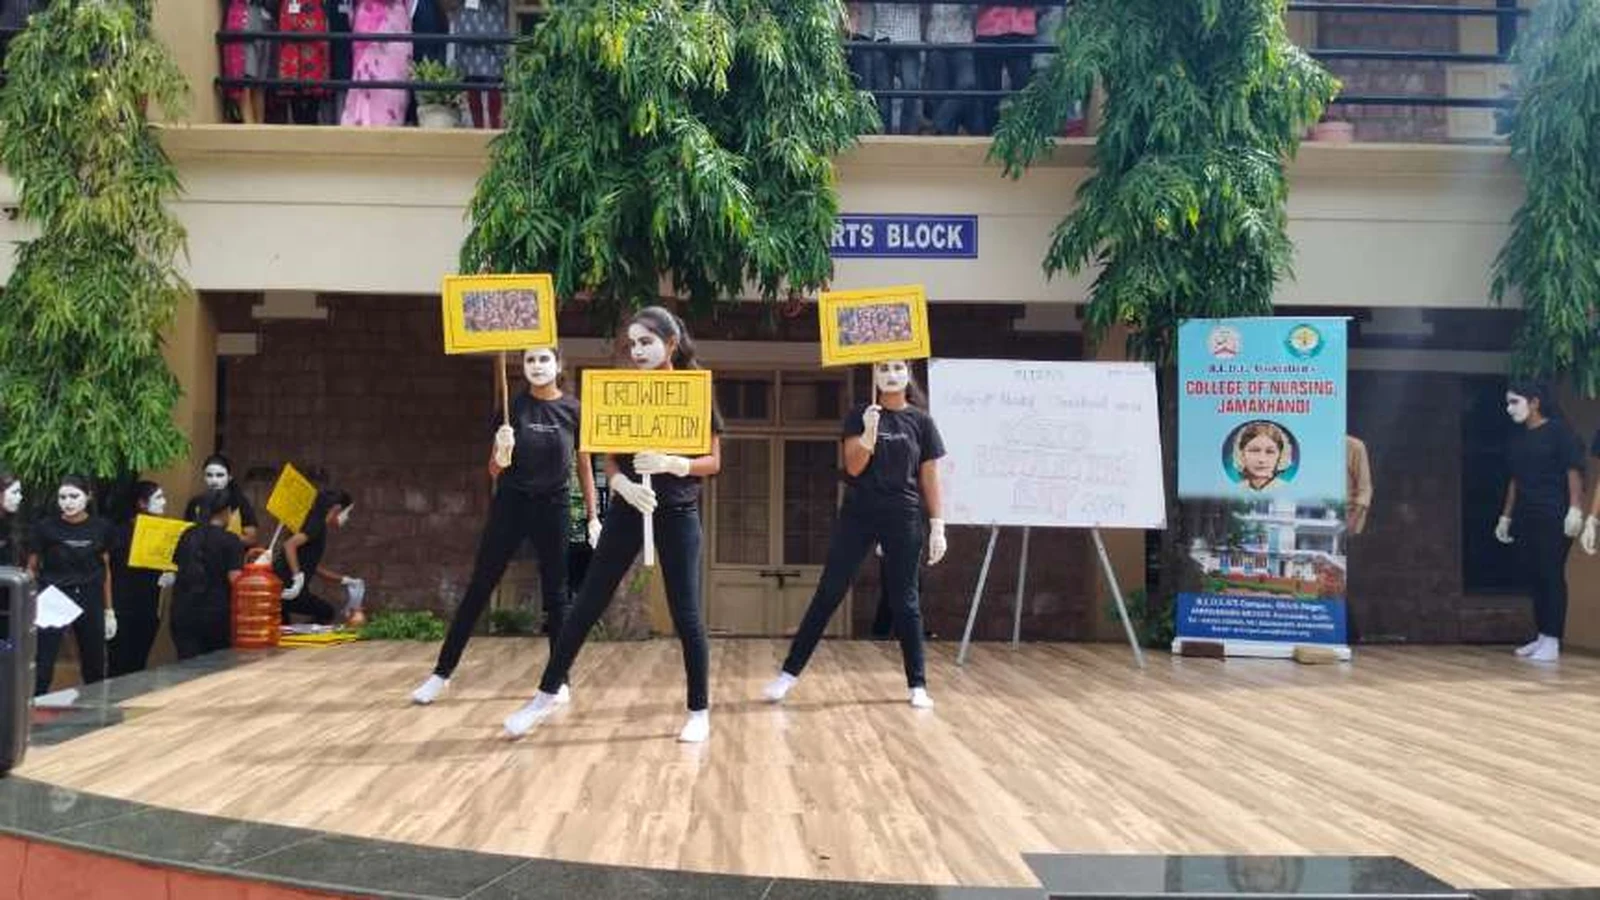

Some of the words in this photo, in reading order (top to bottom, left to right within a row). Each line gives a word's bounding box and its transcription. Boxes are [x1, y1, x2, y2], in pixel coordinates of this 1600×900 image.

[830, 222, 874, 248] RTS
[886, 223, 963, 249] BLOCK
[603, 381, 689, 406] CROWDED
[1186, 380, 1242, 396] COLLEGE
[1247, 380, 1268, 396] OF
[1217, 399, 1311, 414] JAMAKHANDI
[596, 414, 699, 438] POPULATION
